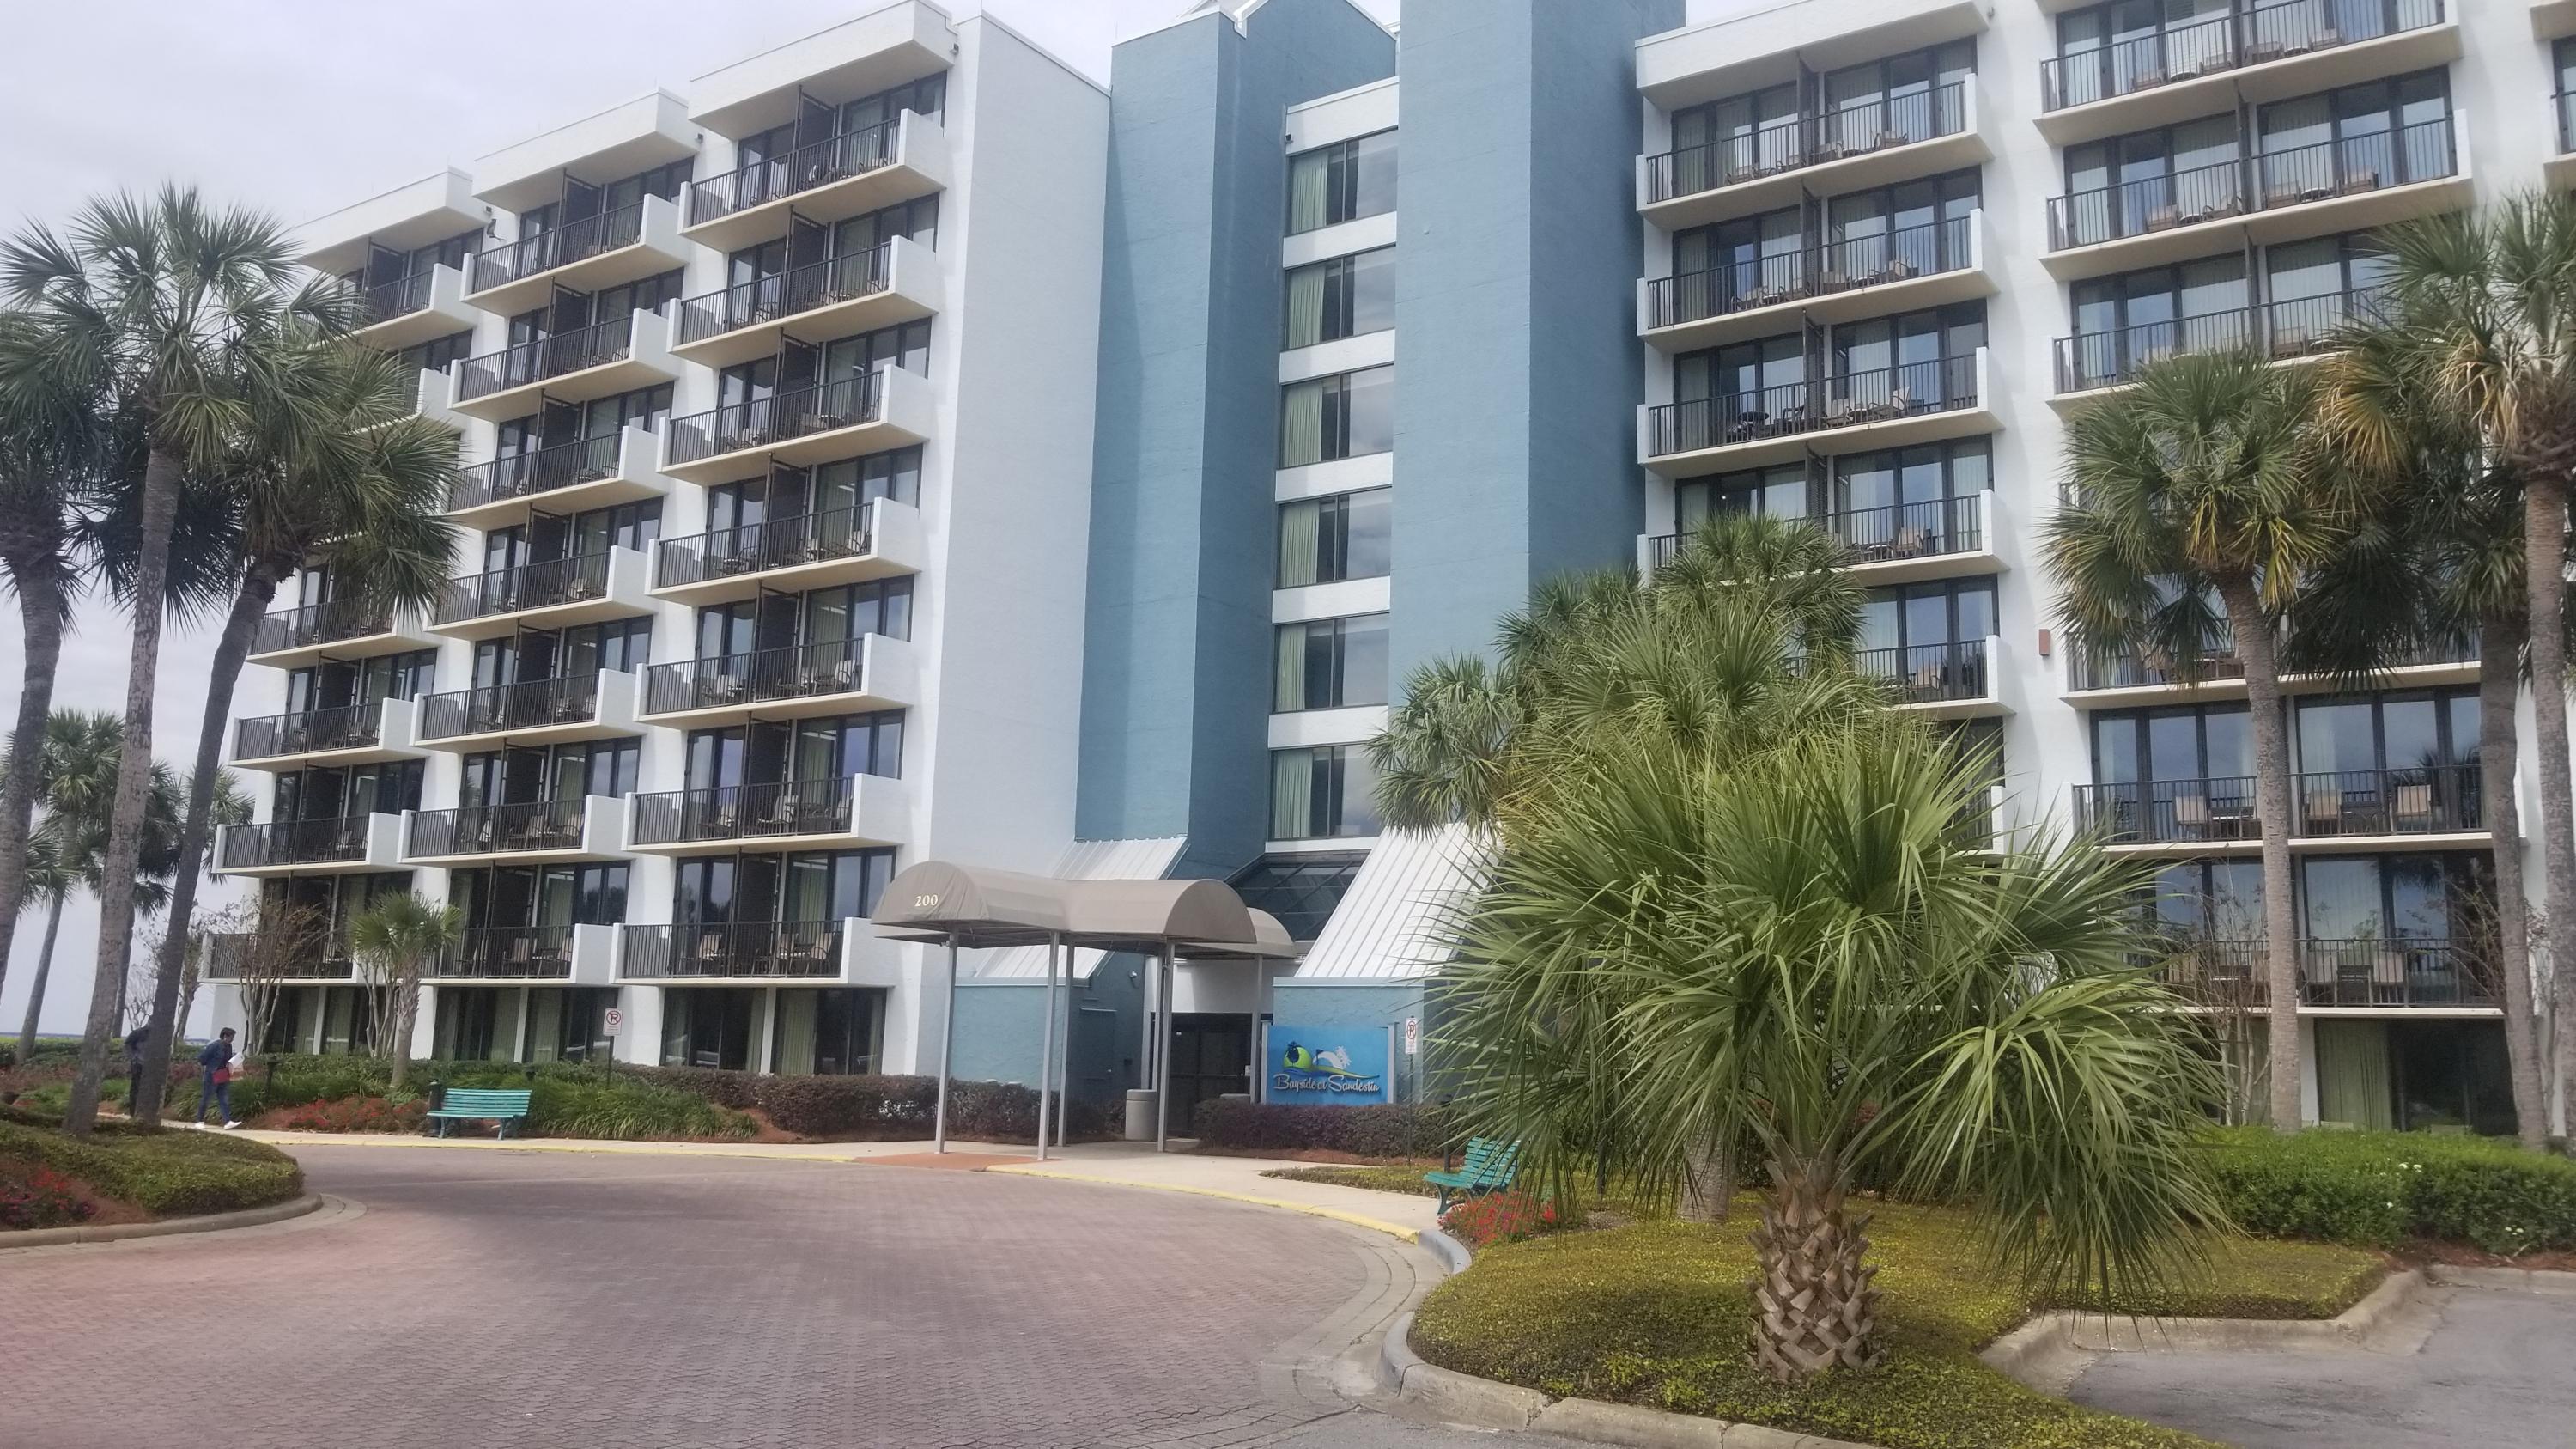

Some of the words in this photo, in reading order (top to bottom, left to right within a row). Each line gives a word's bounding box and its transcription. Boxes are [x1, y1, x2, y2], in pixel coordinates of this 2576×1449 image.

[914, 894, 939, 907] 200
[1273, 1073, 1315, 1092] Bayside
[1317, 1080, 1327, 1090] at
[1328, 1074, 1379, 1093] Sandestin
